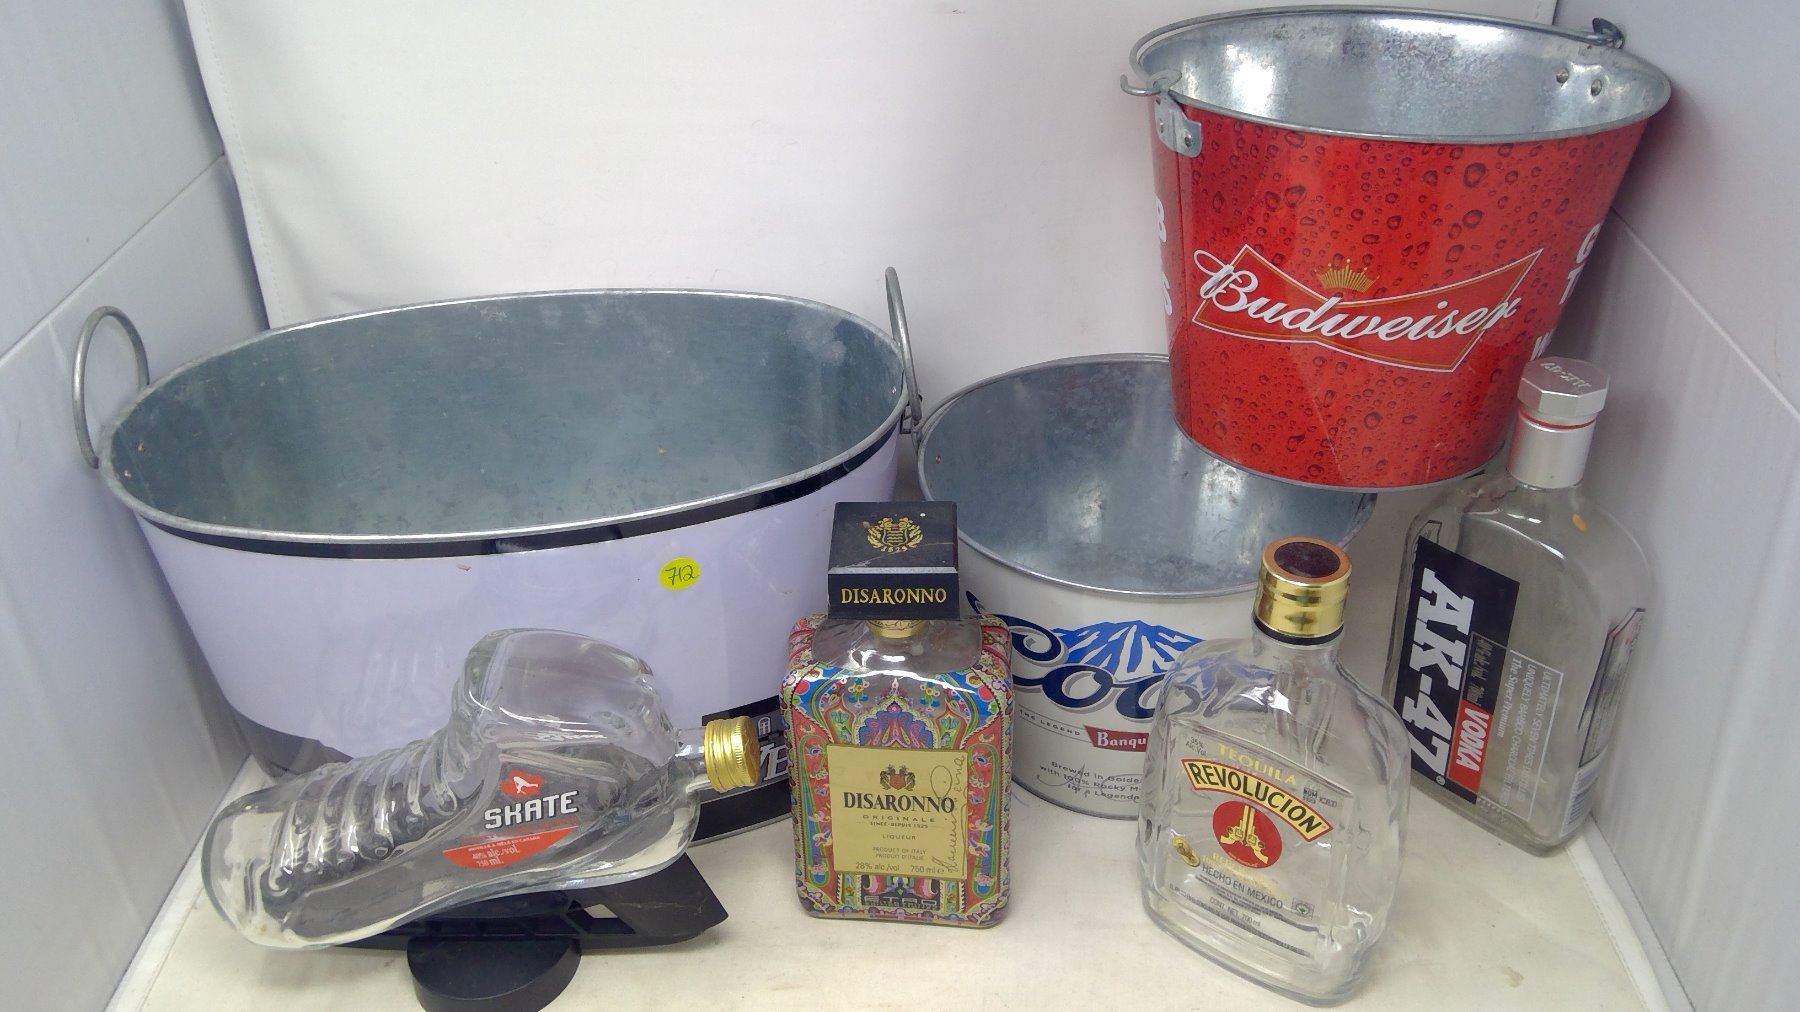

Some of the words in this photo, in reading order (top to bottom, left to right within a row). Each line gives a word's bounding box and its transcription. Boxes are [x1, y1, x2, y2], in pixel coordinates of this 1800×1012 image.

[1193, 249, 1522, 344] Budweiser
[665, 566, 699, 586] 712
[841, 588, 947, 604] DISARONNO
[966, 590, 1190, 722] Coo
[1402, 566, 1475, 777] AK-47
[1508, 657, 1522, 676] The
[1502, 673, 1518, 701] Super
[1518, 662, 1537, 704] UNIQUELY
[1533, 670, 1553, 718] ULTIMATELY
[1040, 720, 1081, 736] LEGEND
[1097, 731, 1147, 748] Banqu
[1497, 699, 1514, 738] Premium
[1512, 702, 1529, 737] BAMBOO
[1527, 717, 1543, 744] SEVEN
[1456, 707, 1490, 772] VODKA
[1040, 765, 1060, 777] with
[1064, 773, 1089, 786] 100%
[1093, 782, 1126, 792] Rocky
[1051, 761, 1090, 777] Brewed
[1217, 743, 1297, 786] TEQUILA
[484, 790, 579, 830] SKATE
[843, 791, 955, 814] DISARONNO
[1188, 762, 1323, 834] REVOLUCION
[862, 814, 936, 823] ORIGINALE
[855, 861, 873, 870] 28%
[911, 865, 925, 874] 750
[926, 865, 936, 874] ml
[1201, 863, 1232, 886] HECHO
[1232, 881, 1246, 893] EN
[1246, 887, 1284, 910] MEXICO
